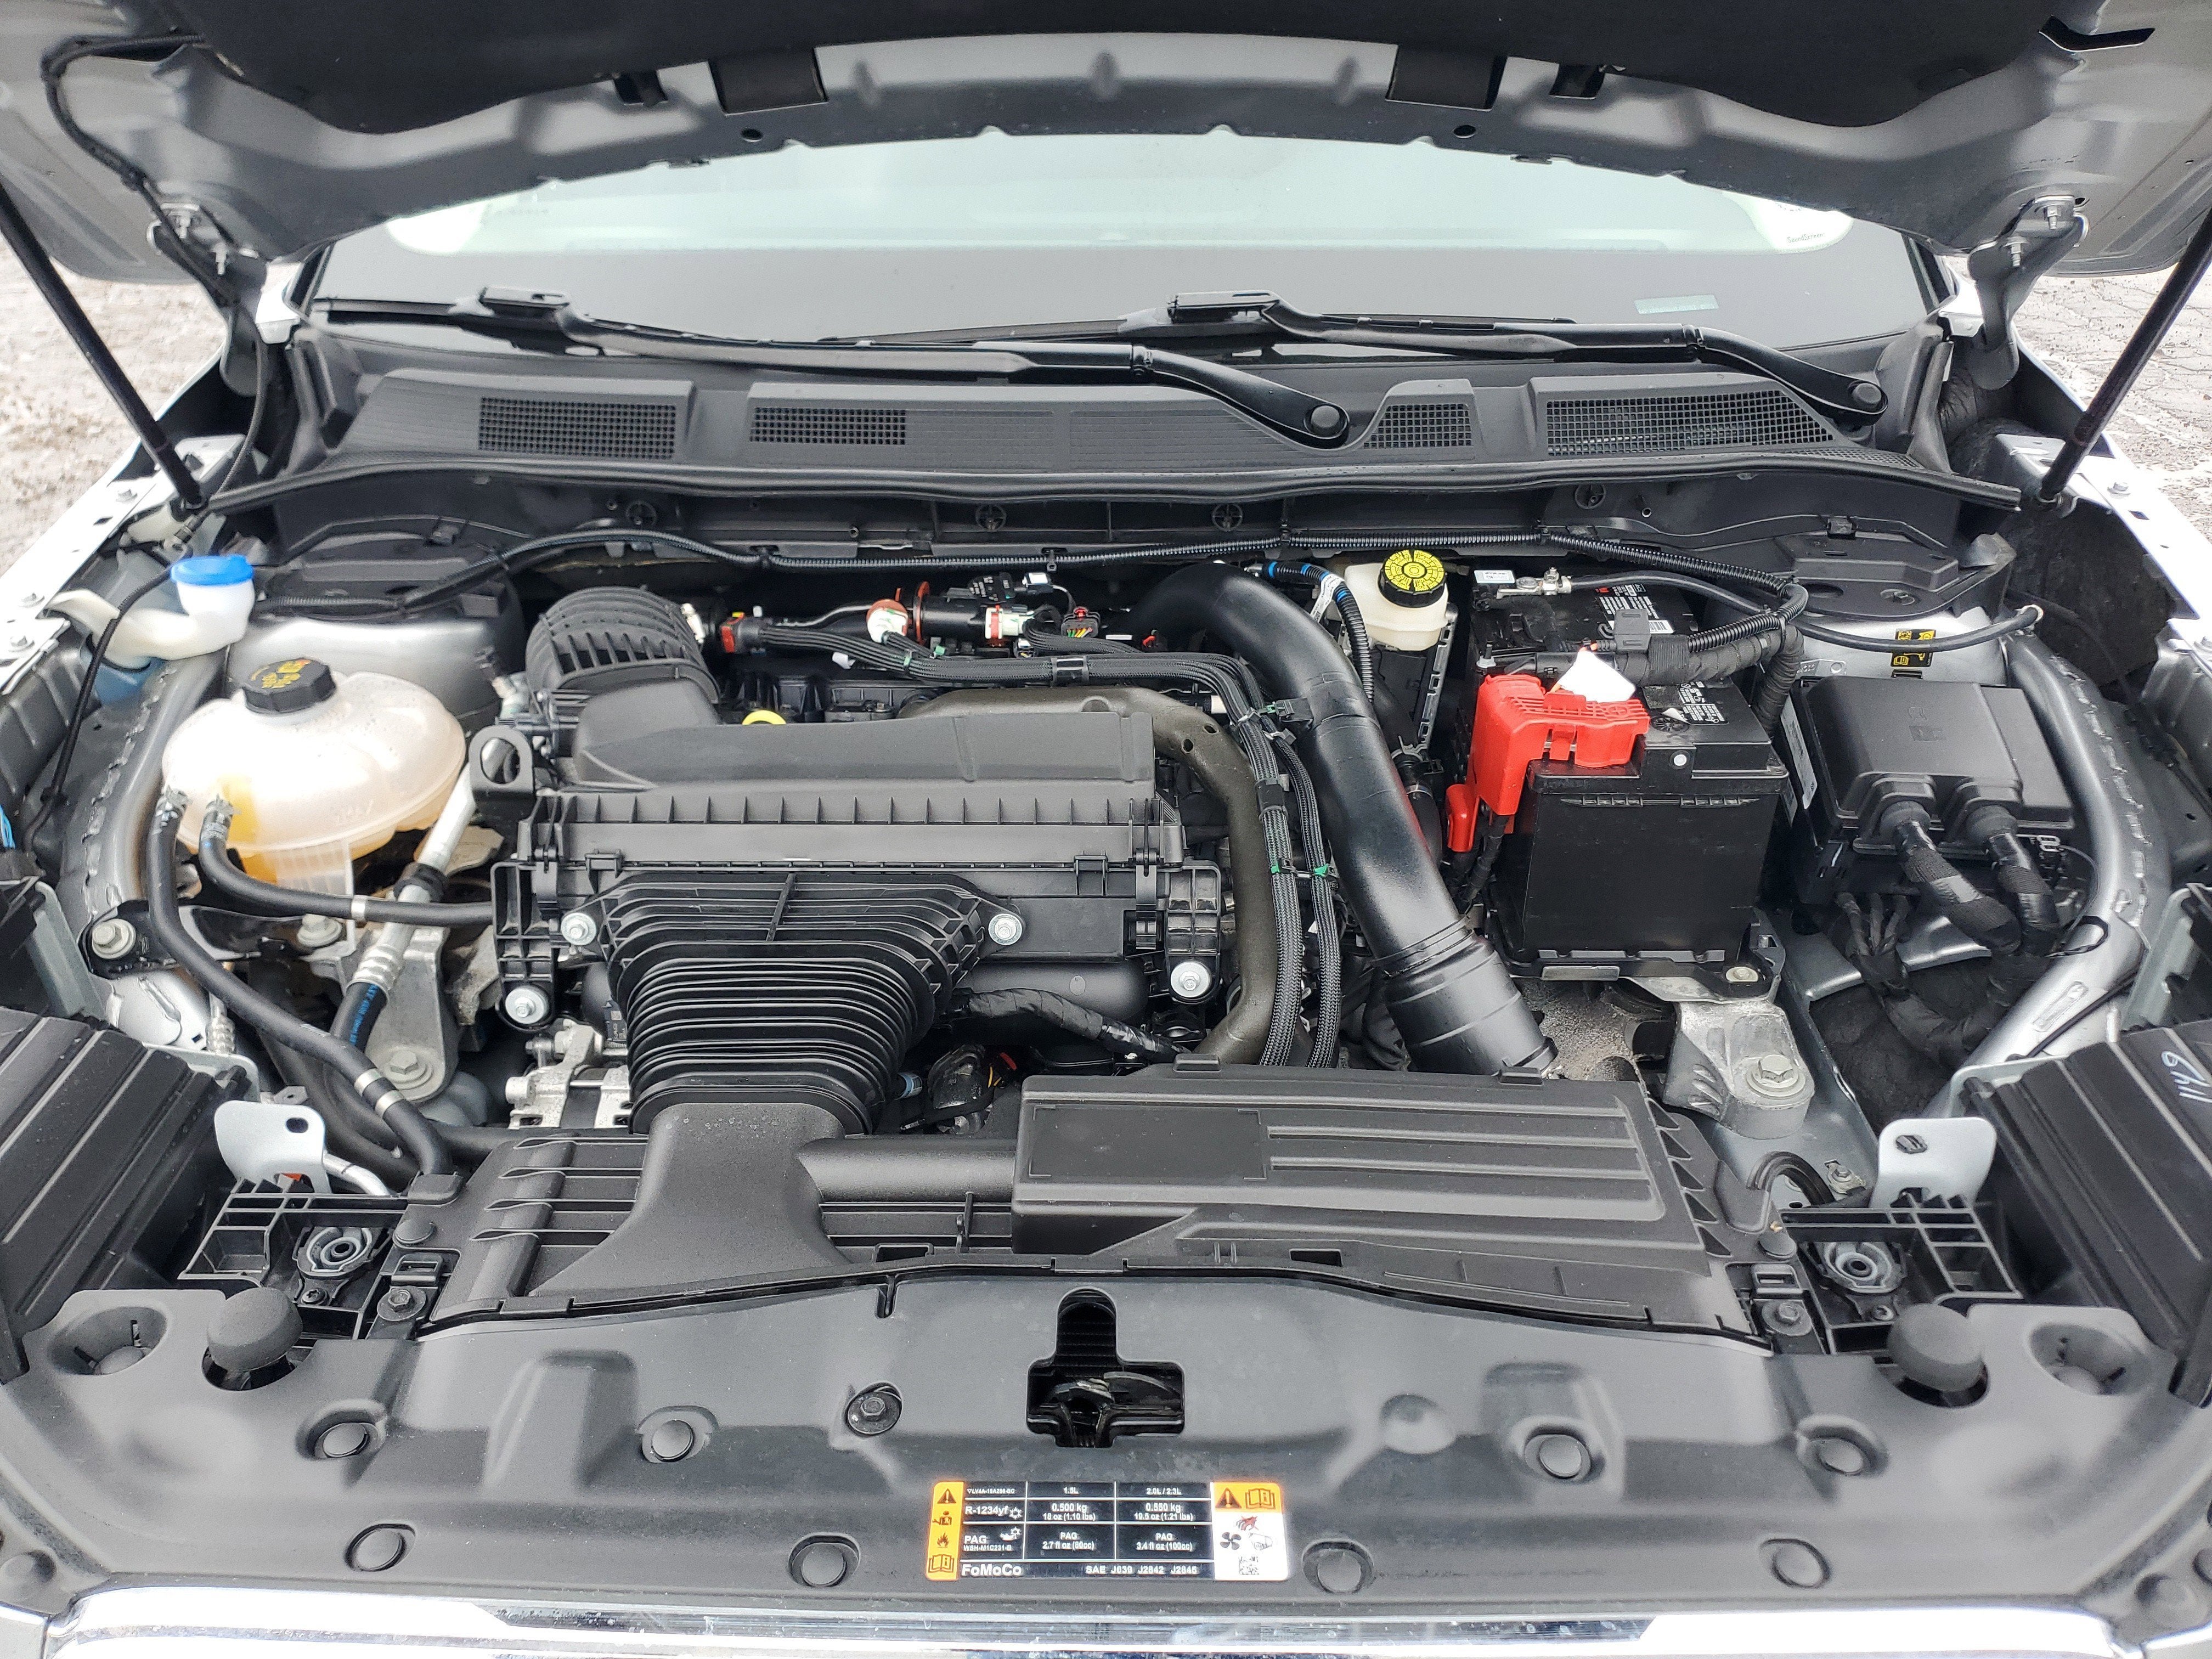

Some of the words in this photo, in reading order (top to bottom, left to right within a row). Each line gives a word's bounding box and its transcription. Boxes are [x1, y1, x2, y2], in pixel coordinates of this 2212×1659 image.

[965, 1505, 1008, 1516] R-1234yf
[1052, 1503, 1075, 1512] 0.500
[1076, 1503, 1087, 1513] kg
[1146, 1503, 1169, 1512] 0.550
[1170, 1503, 1181, 1514] kg
[1064, 1513, 1081, 1521] (1.10
[1082, 1513, 1096, 1521] lbs)
[1161, 1513, 1178, 1521] (1.21
[1180, 1513, 1193, 1521] lbs)
[964, 1535, 988, 1544] PAG
[1059, 1531, 1077, 1539] PAG
[1042, 1541, 1053, 1549] 2.7
[1054, 1541, 1060, 1549] fl
[1072, 1541, 1094, 1551] (80cc)
[1136, 1542, 1147, 1550] 3.4
[1166, 1542, 1193, 1551] (100cc)
[962, 1563, 1022, 1576] FoMoCo
[1086, 1565, 1106, 1575] SAE
